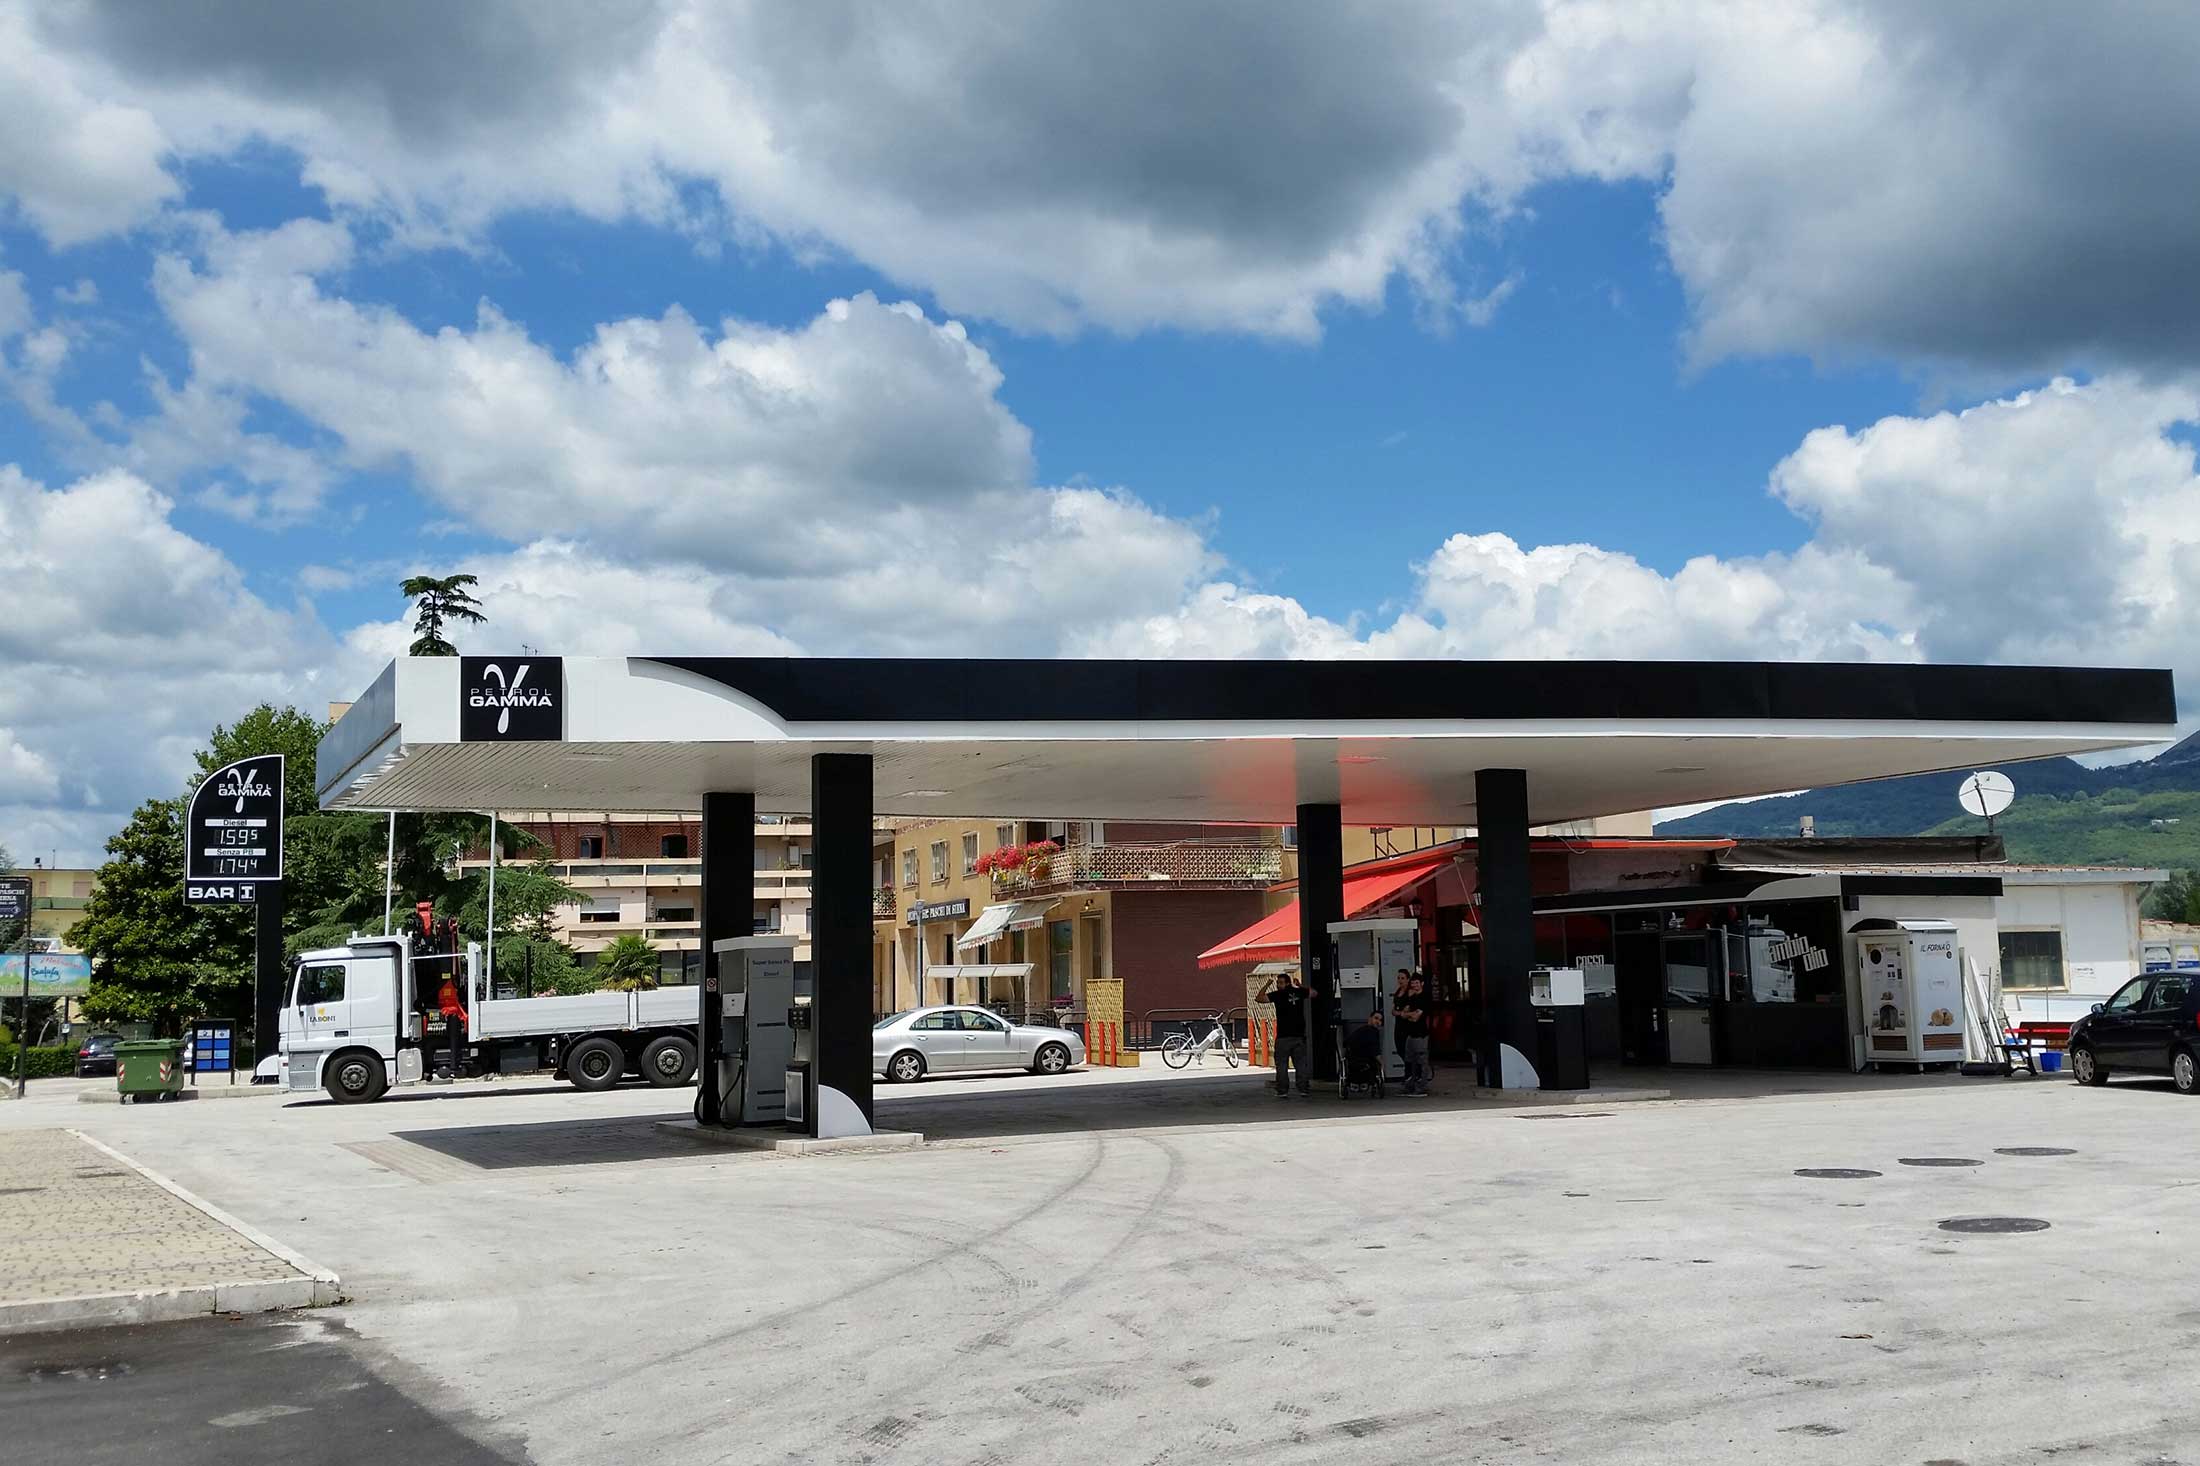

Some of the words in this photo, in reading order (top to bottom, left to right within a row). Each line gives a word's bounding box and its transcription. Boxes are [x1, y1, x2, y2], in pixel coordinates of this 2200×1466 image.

[470, 688, 552, 696] PETROL
[469, 696, 553, 707] GAMMA
[218, 789, 272, 797] GAMMA
[188, 887, 235, 899] BAR
